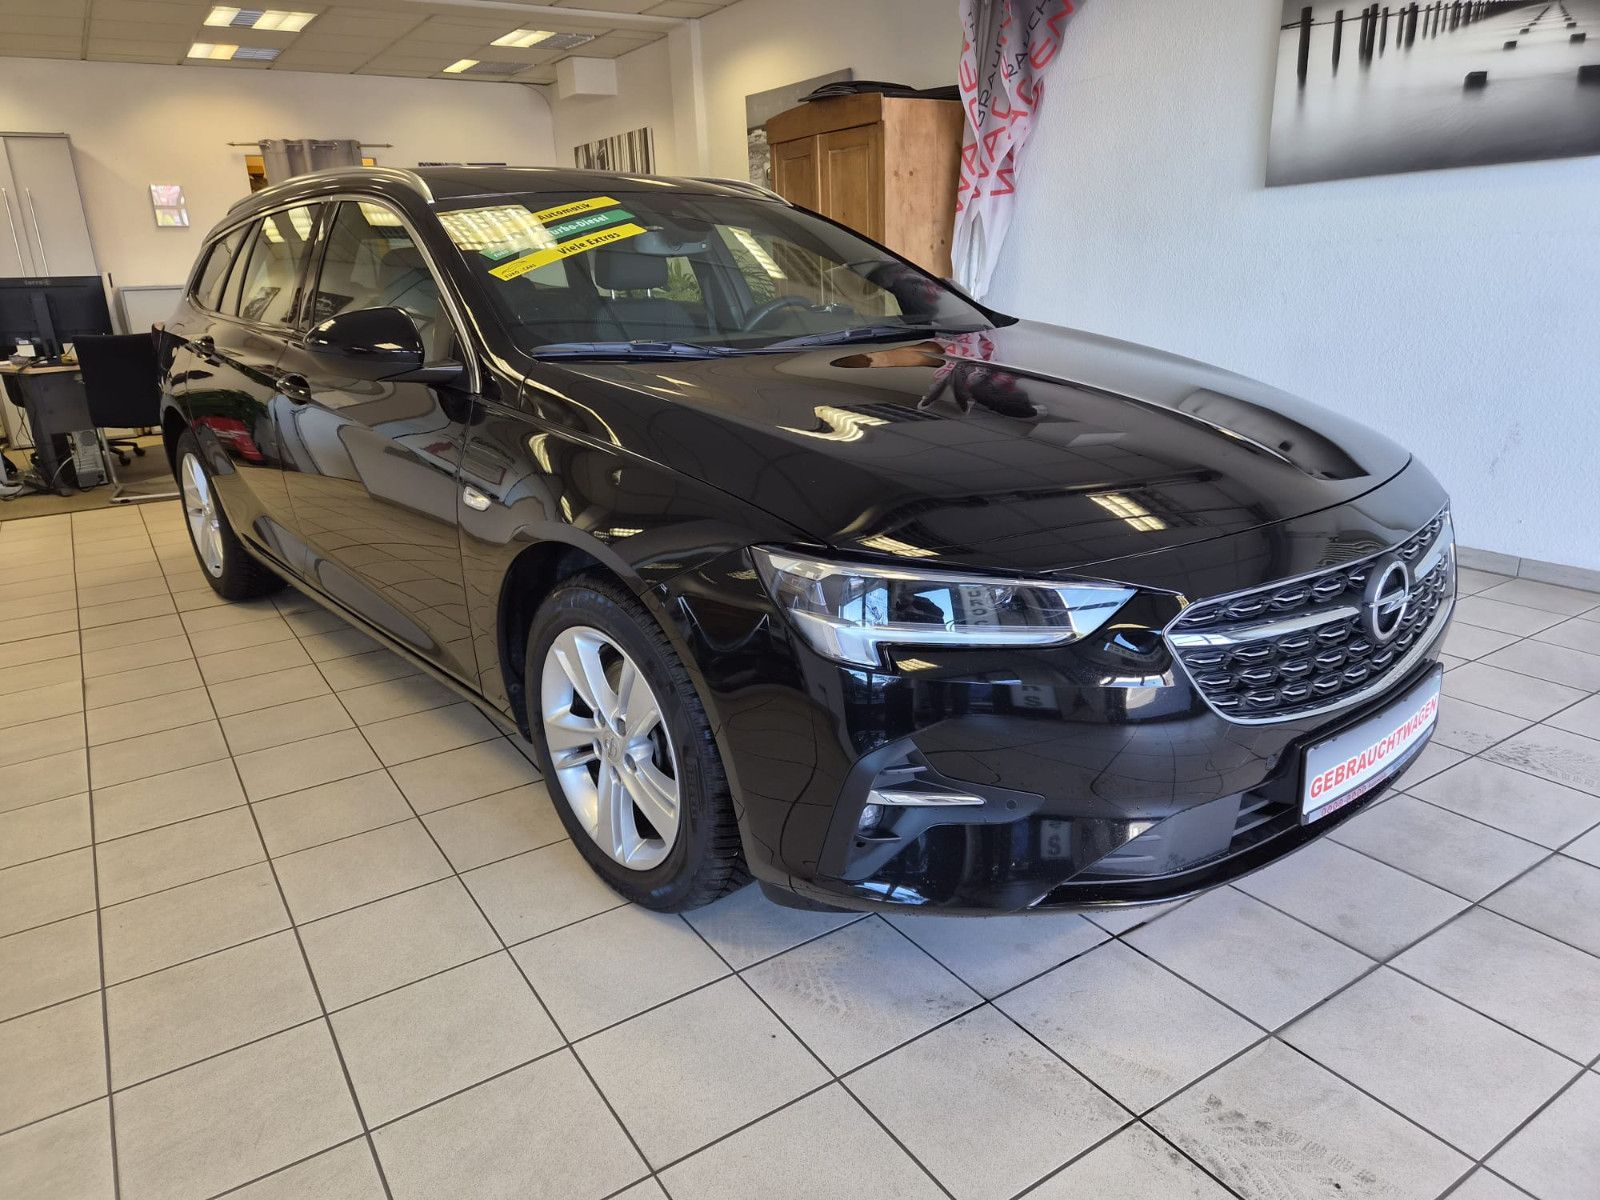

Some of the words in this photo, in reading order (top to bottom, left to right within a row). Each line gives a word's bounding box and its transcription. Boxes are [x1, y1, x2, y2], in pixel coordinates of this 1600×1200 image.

[538, 203, 592, 221] Automatik
[558, 241, 587, 255] Viele
[588, 231, 621, 246] Extras
[1310, 698, 1437, 799] GEBRAUCHTWAGEN
